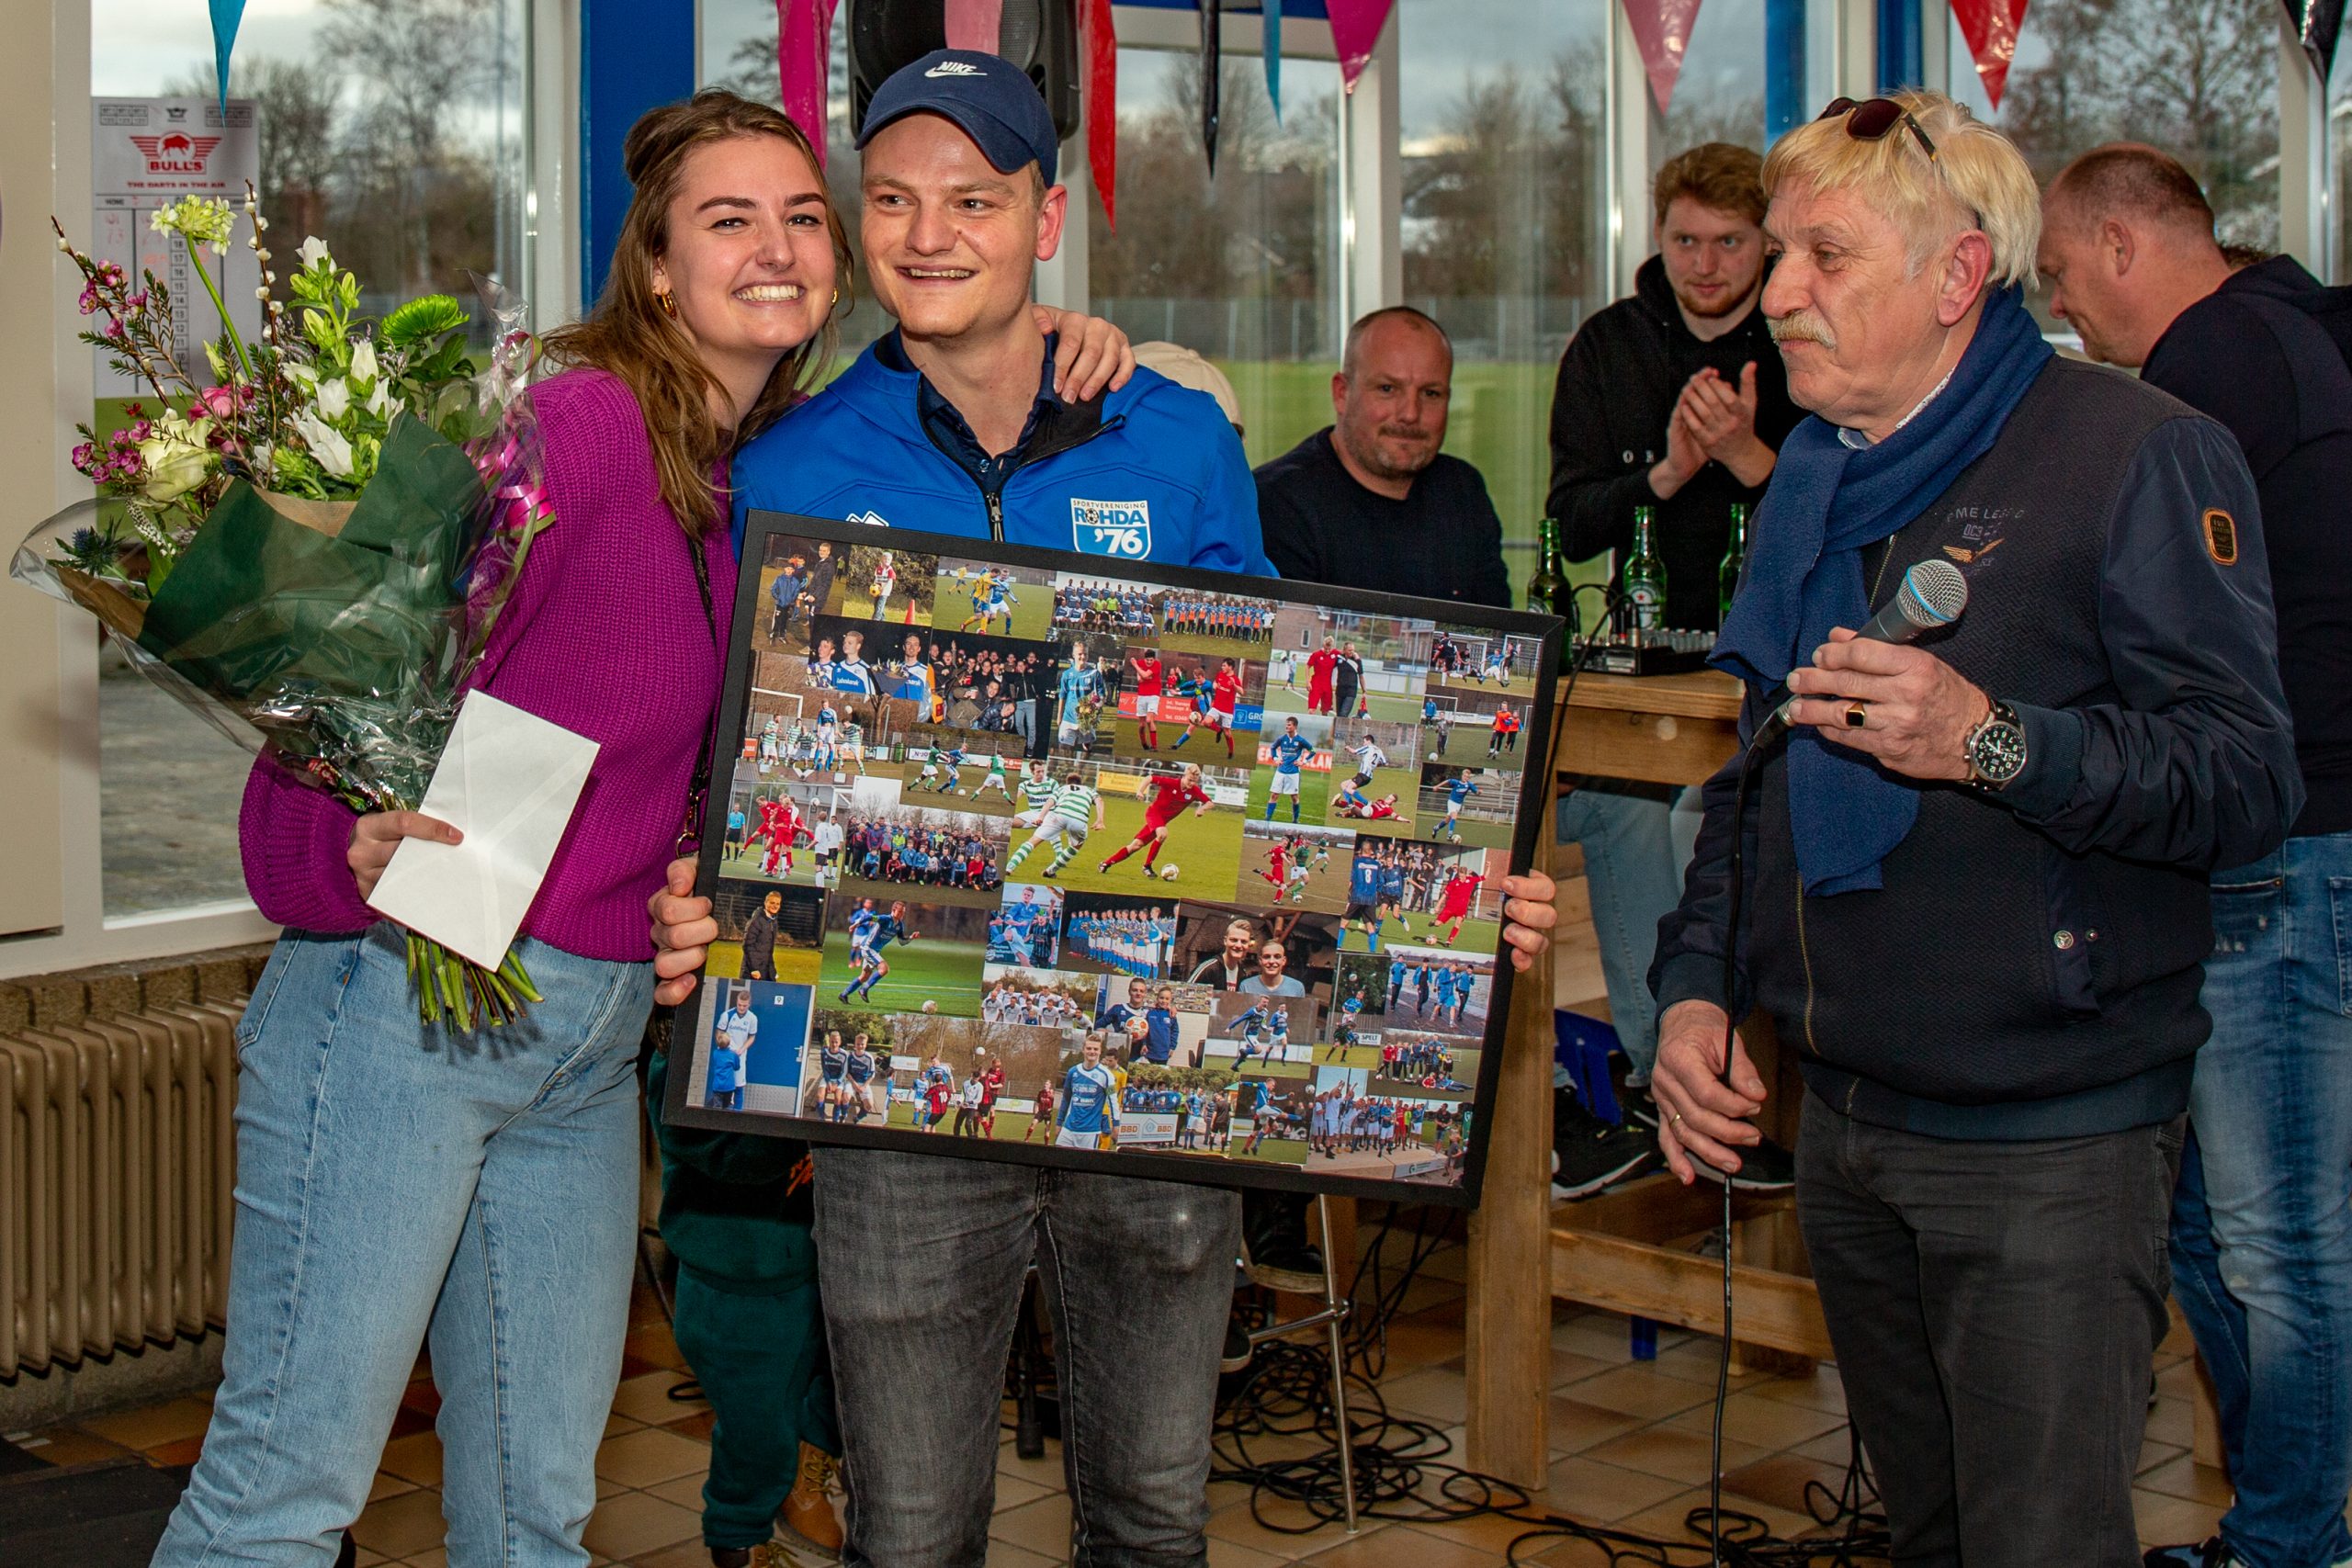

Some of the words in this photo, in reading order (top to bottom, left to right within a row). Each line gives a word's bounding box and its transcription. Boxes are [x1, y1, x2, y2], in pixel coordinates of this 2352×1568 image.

[937, 62, 977, 73] NIKE
[150, 161, 203, 172] BULL'S
[1073, 500, 1146, 509] SPORTVERENIGING
[1372, 753, 1377, 764] 2
[1365, 869, 1372, 884] 8
[939, 1091, 948, 1103] 10
